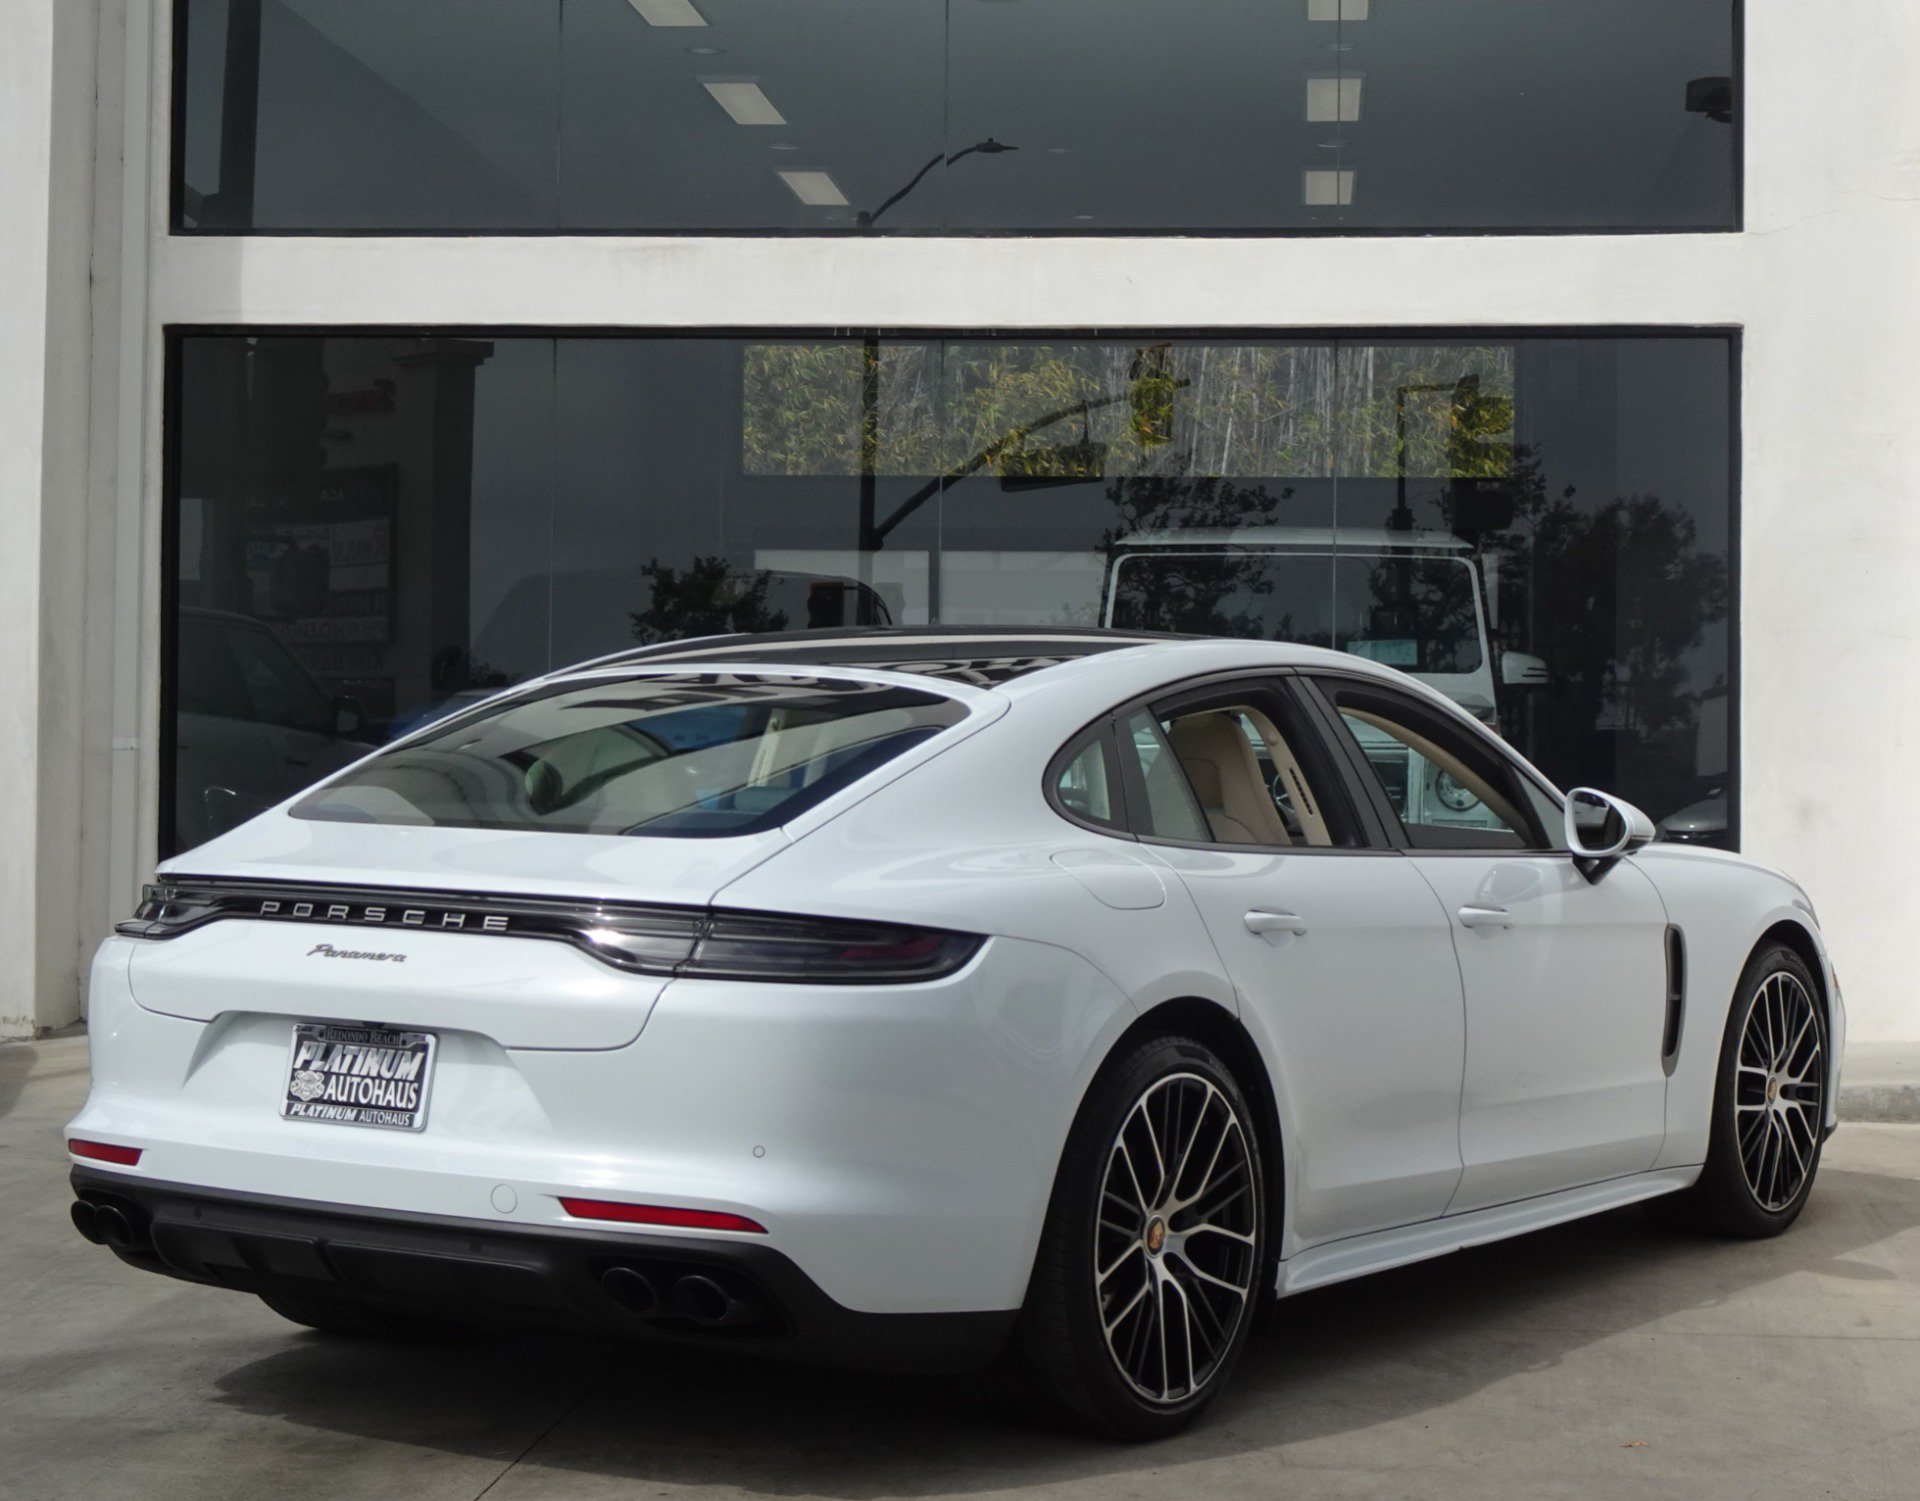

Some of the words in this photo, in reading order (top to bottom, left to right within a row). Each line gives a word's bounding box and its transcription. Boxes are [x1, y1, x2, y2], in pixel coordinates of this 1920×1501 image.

[260, 901, 509, 930] PORSCHE
[306, 943, 407, 962] Panamera
[293, 1041, 425, 1081] PLATINUM
[323, 1075, 419, 1109] AUTOHAUS
[290, 1104, 357, 1121] PLATINUM
[359, 1111, 410, 1126] AUTOHAUS
